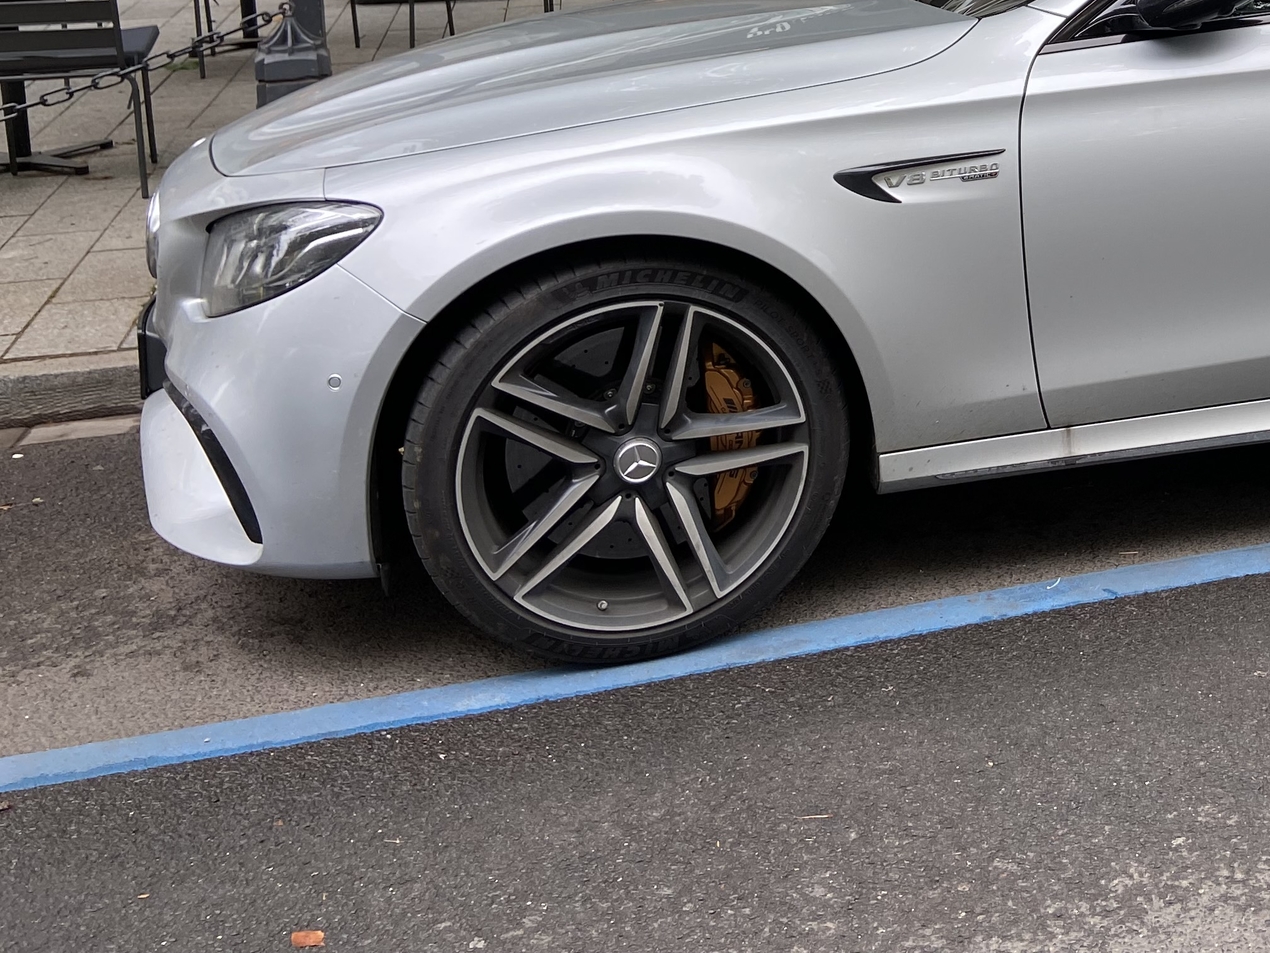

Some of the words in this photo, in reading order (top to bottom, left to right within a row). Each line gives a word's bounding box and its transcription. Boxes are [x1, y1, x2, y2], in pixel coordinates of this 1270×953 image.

[884, 171, 926, 188] V8
[930, 162, 999, 178] BITURBO
[597, 268, 743, 302] MICHELIN
